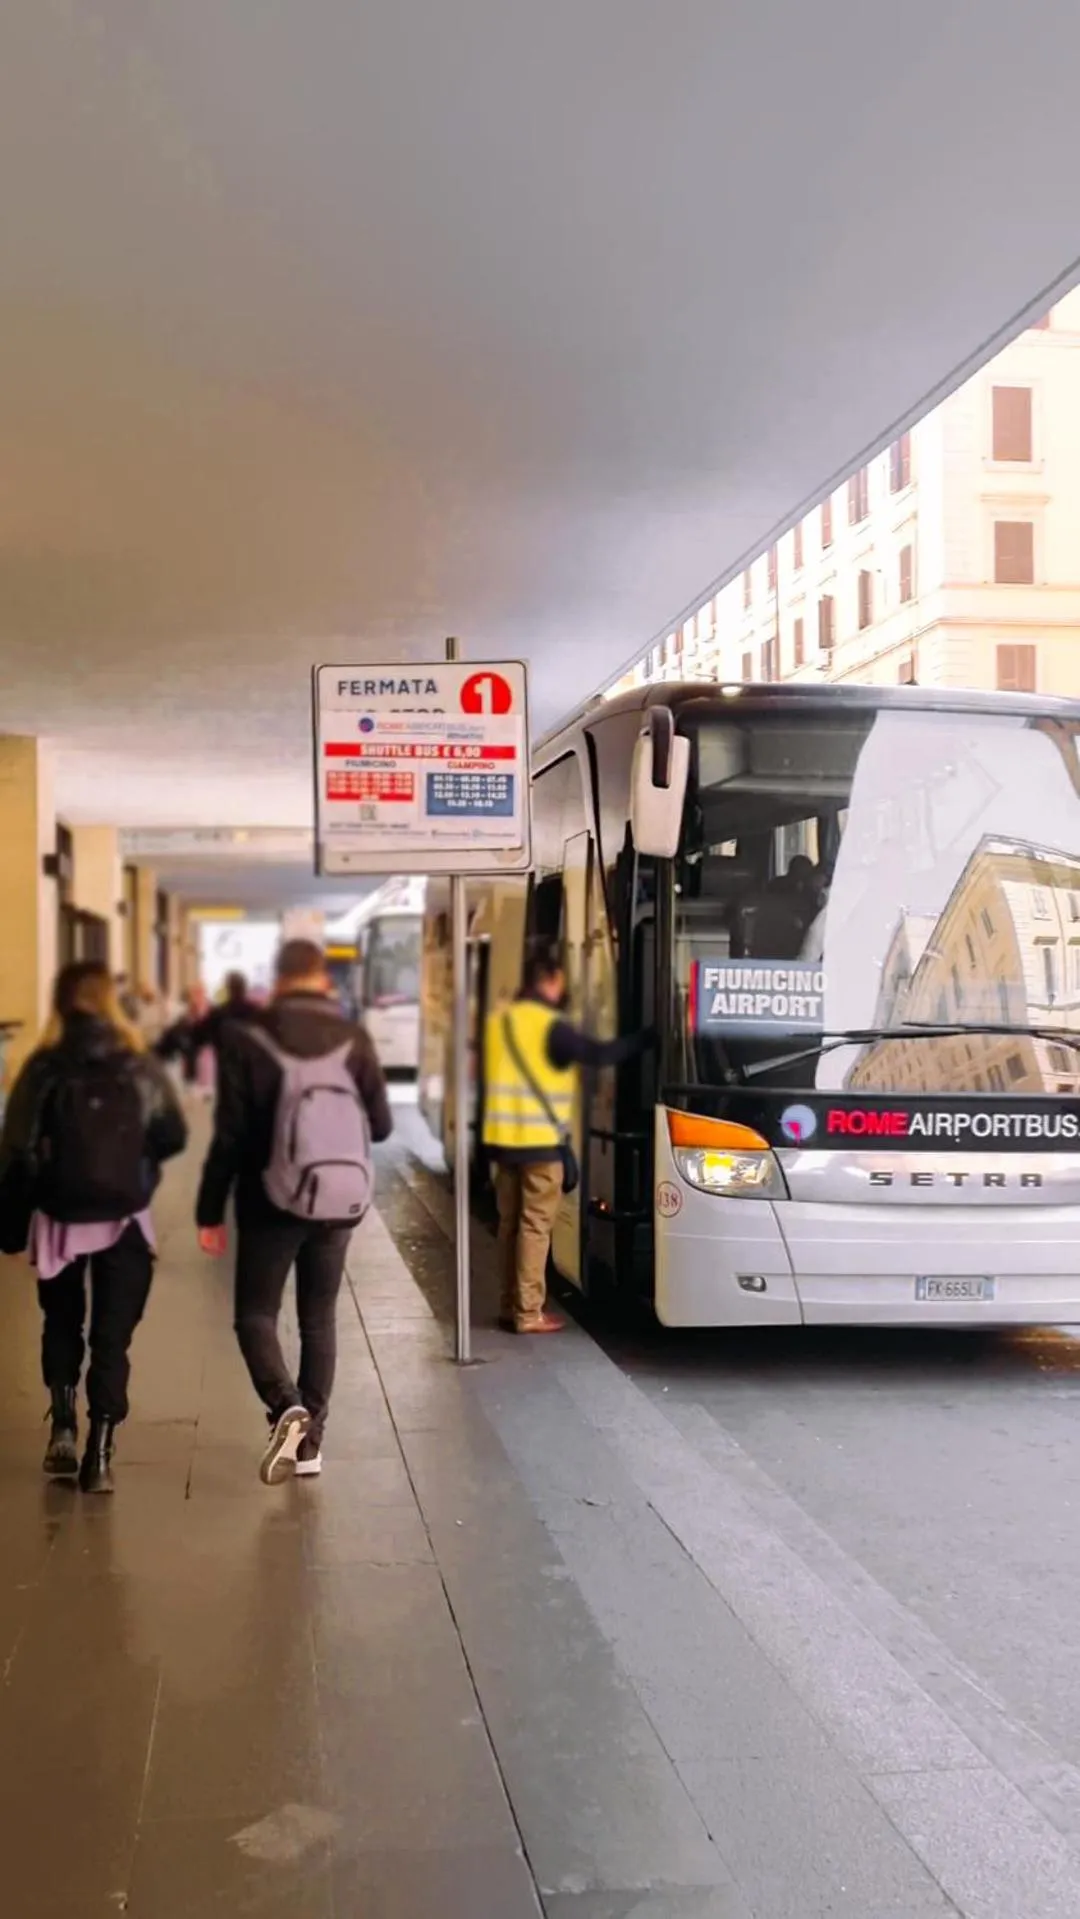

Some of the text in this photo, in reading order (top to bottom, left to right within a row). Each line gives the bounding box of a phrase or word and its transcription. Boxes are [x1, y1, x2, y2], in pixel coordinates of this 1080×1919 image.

[337, 679, 438, 696] FERMATA
[473, 677, 494, 714] 1
[360, 744, 411, 758] SHUTTLE
[414, 745, 440, 758] BUS
[447, 761, 496, 770] CIAMPINO
[704, 967, 828, 992] FIUMICINO
[711, 993, 822, 1017] AIRPORT
[869, 1172, 1043, 1187] SETRA
